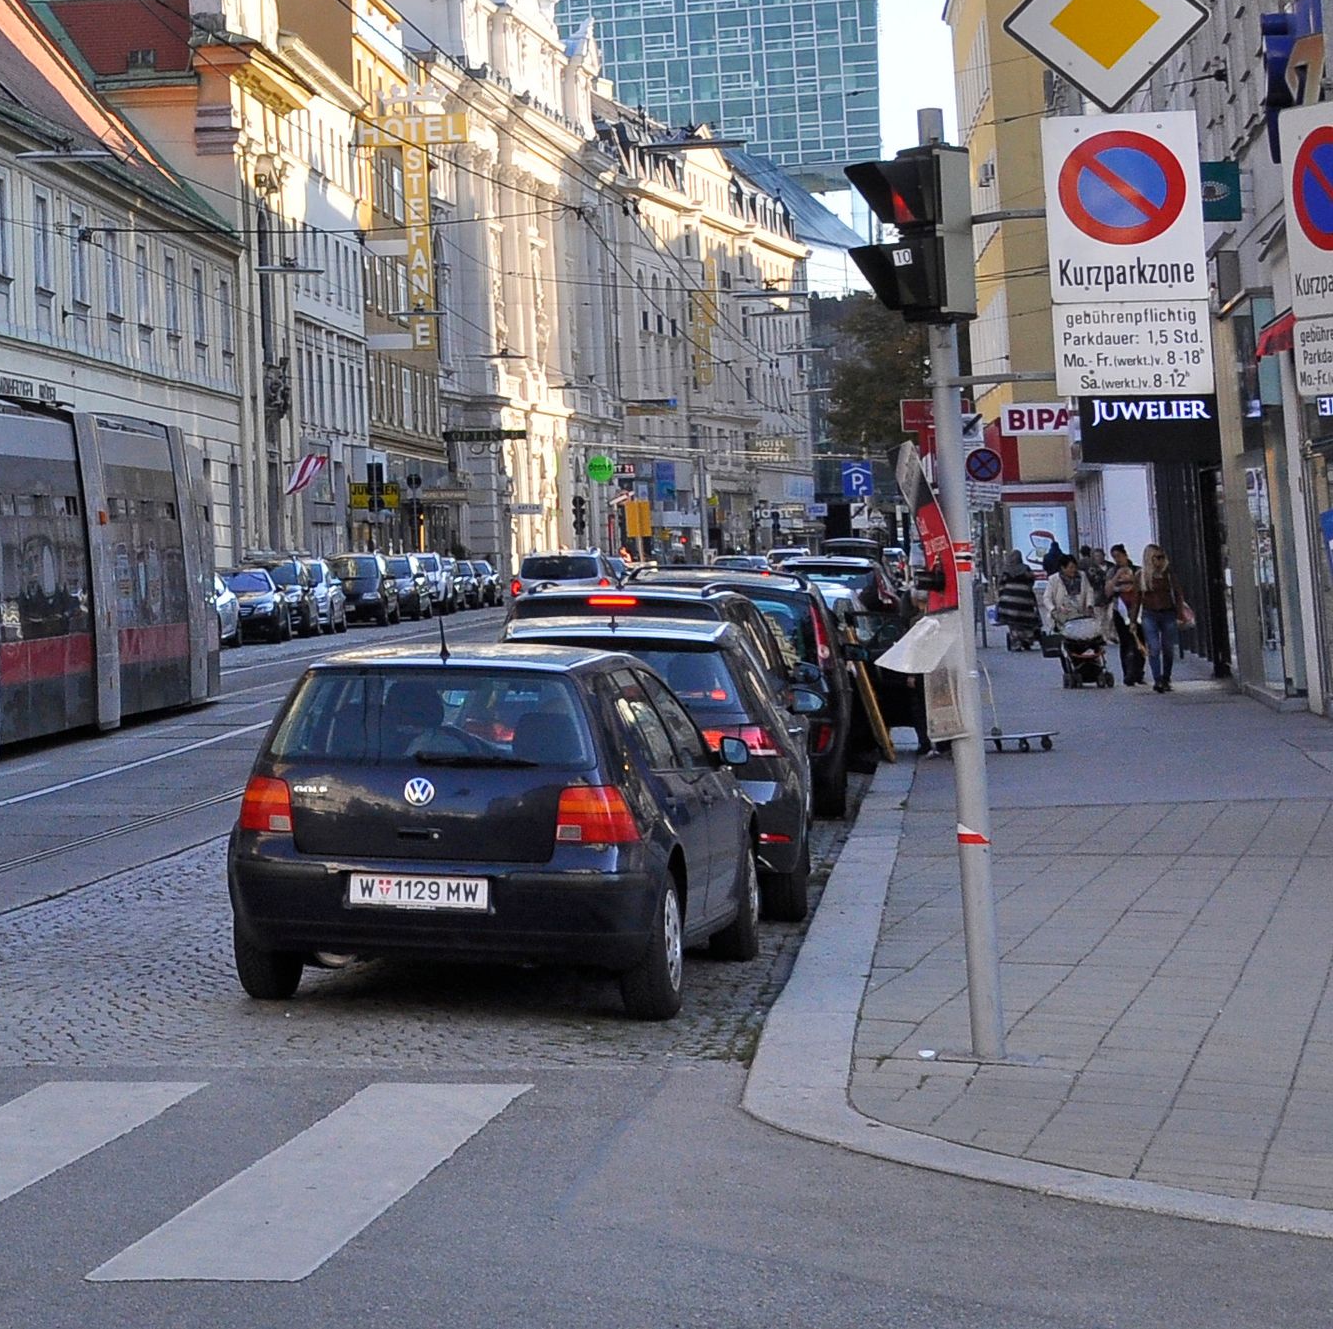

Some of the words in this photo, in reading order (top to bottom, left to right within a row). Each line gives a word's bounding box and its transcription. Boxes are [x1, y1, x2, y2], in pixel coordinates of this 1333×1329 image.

[357, 113, 461, 144] HOTEL
[895, 250, 910, 264] 10
[1058, 257, 1195, 292] Kurzparkzone
[1066, 306, 1197, 328] gebührenpflichtig
[1063, 331, 1140, 346] Parkdauer:
[1147, 330, 1169, 347] 1,5
[1173, 328, 1204, 344] Std.
[1008, 409, 1069, 431] BIPA
[1091, 399, 1212, 427] JUWELIER
[752, 509, 791, 519] HOEL
[360, 878, 375, 898] W
[394, 880, 440, 901] 1129
[446, 882, 479, 903] MW
